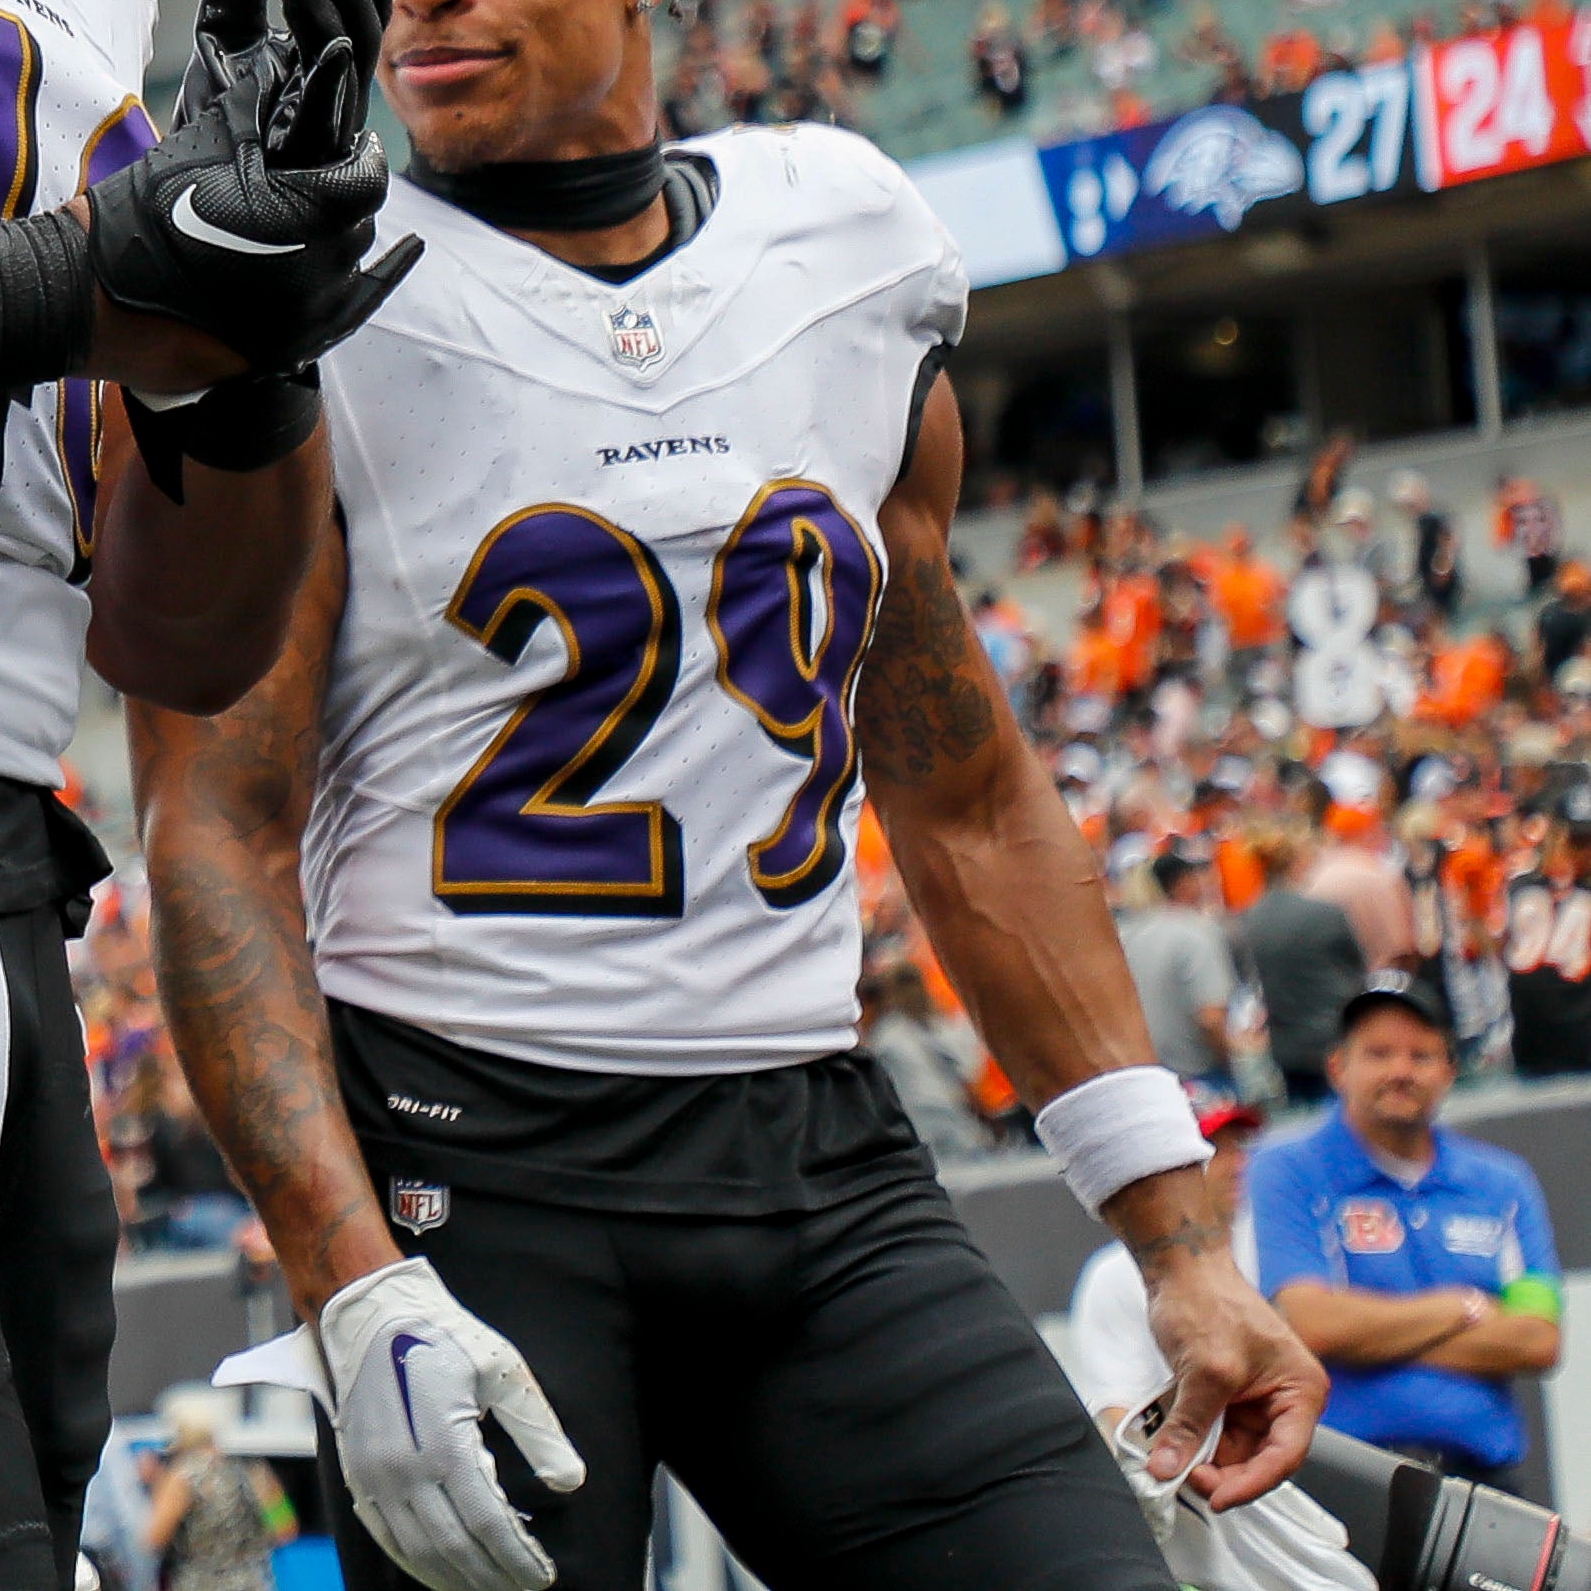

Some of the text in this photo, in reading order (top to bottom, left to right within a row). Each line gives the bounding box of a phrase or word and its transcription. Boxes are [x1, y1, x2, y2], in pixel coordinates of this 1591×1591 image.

[1439, 23, 1557, 175] 24
[1302, 59, 1410, 206] 27
[617, 331, 658, 358] NFL
[596, 436, 731, 467] RAVENS
[434, 478, 883, 917] 29
[387, 1095, 463, 1122] DRI-FIT
[399, 1193, 440, 1220] NFL
